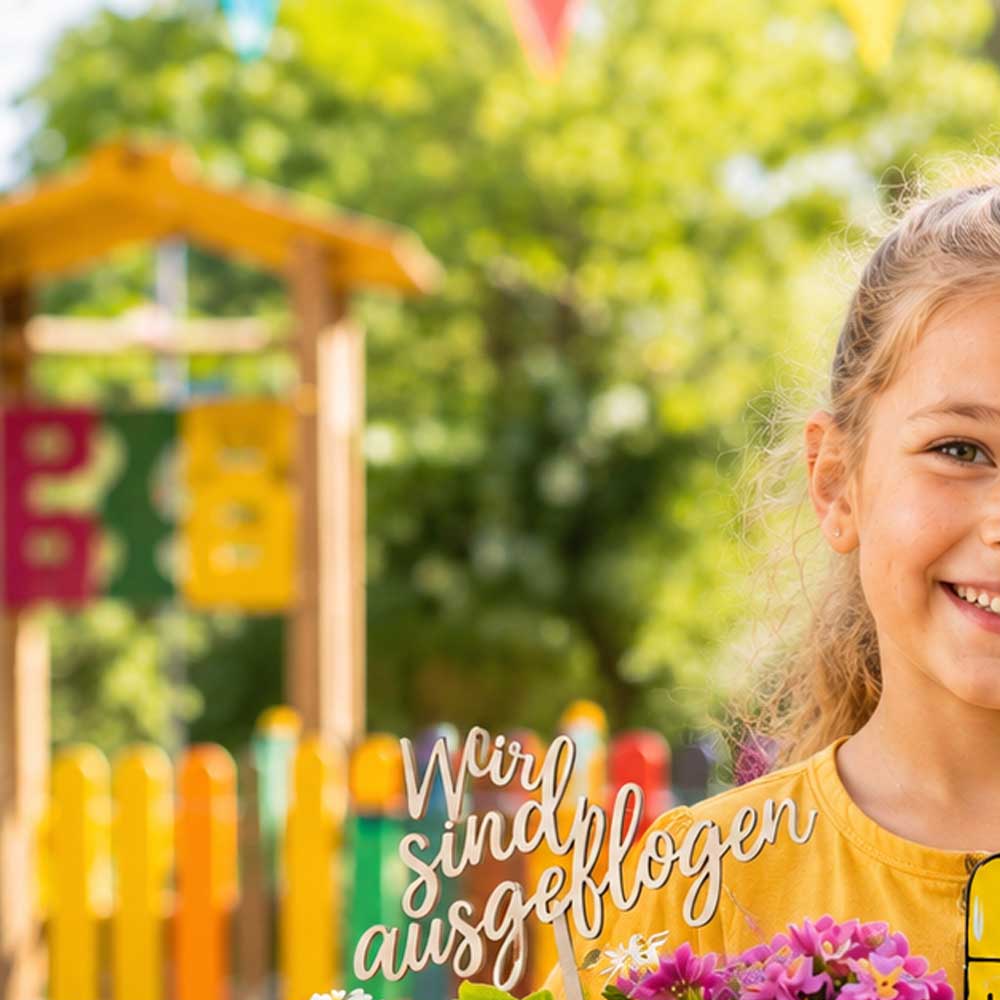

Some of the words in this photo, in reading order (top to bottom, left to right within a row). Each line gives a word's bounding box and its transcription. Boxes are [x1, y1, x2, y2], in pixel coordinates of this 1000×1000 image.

[398, 733, 576, 918] sind
[399, 725, 544, 822] Wir
[352, 782, 818, 992] ausgeflogen
